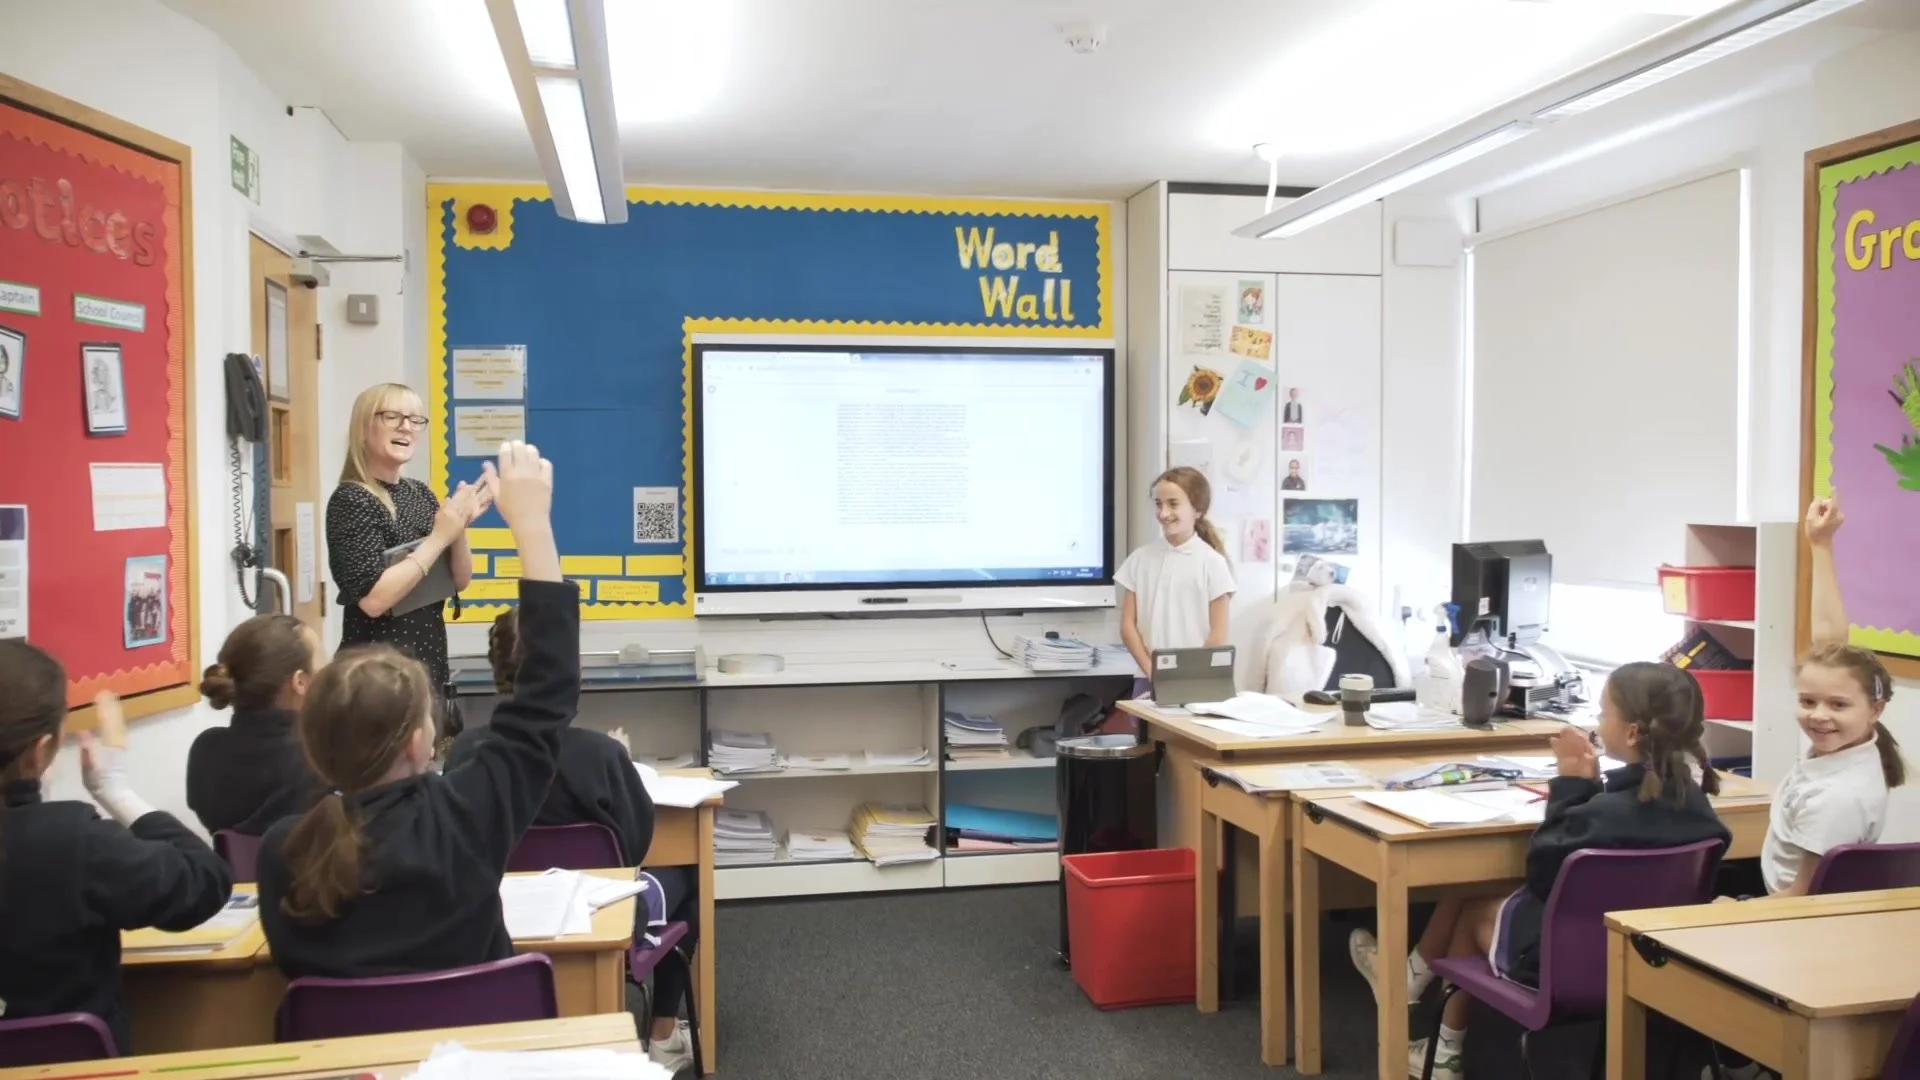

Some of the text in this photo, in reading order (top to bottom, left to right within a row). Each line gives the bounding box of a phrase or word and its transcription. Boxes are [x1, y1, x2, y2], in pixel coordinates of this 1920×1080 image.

[955, 226, 1063, 273] Word
[77, 300, 107, 318] School
[978, 275, 1075, 321] Wall
